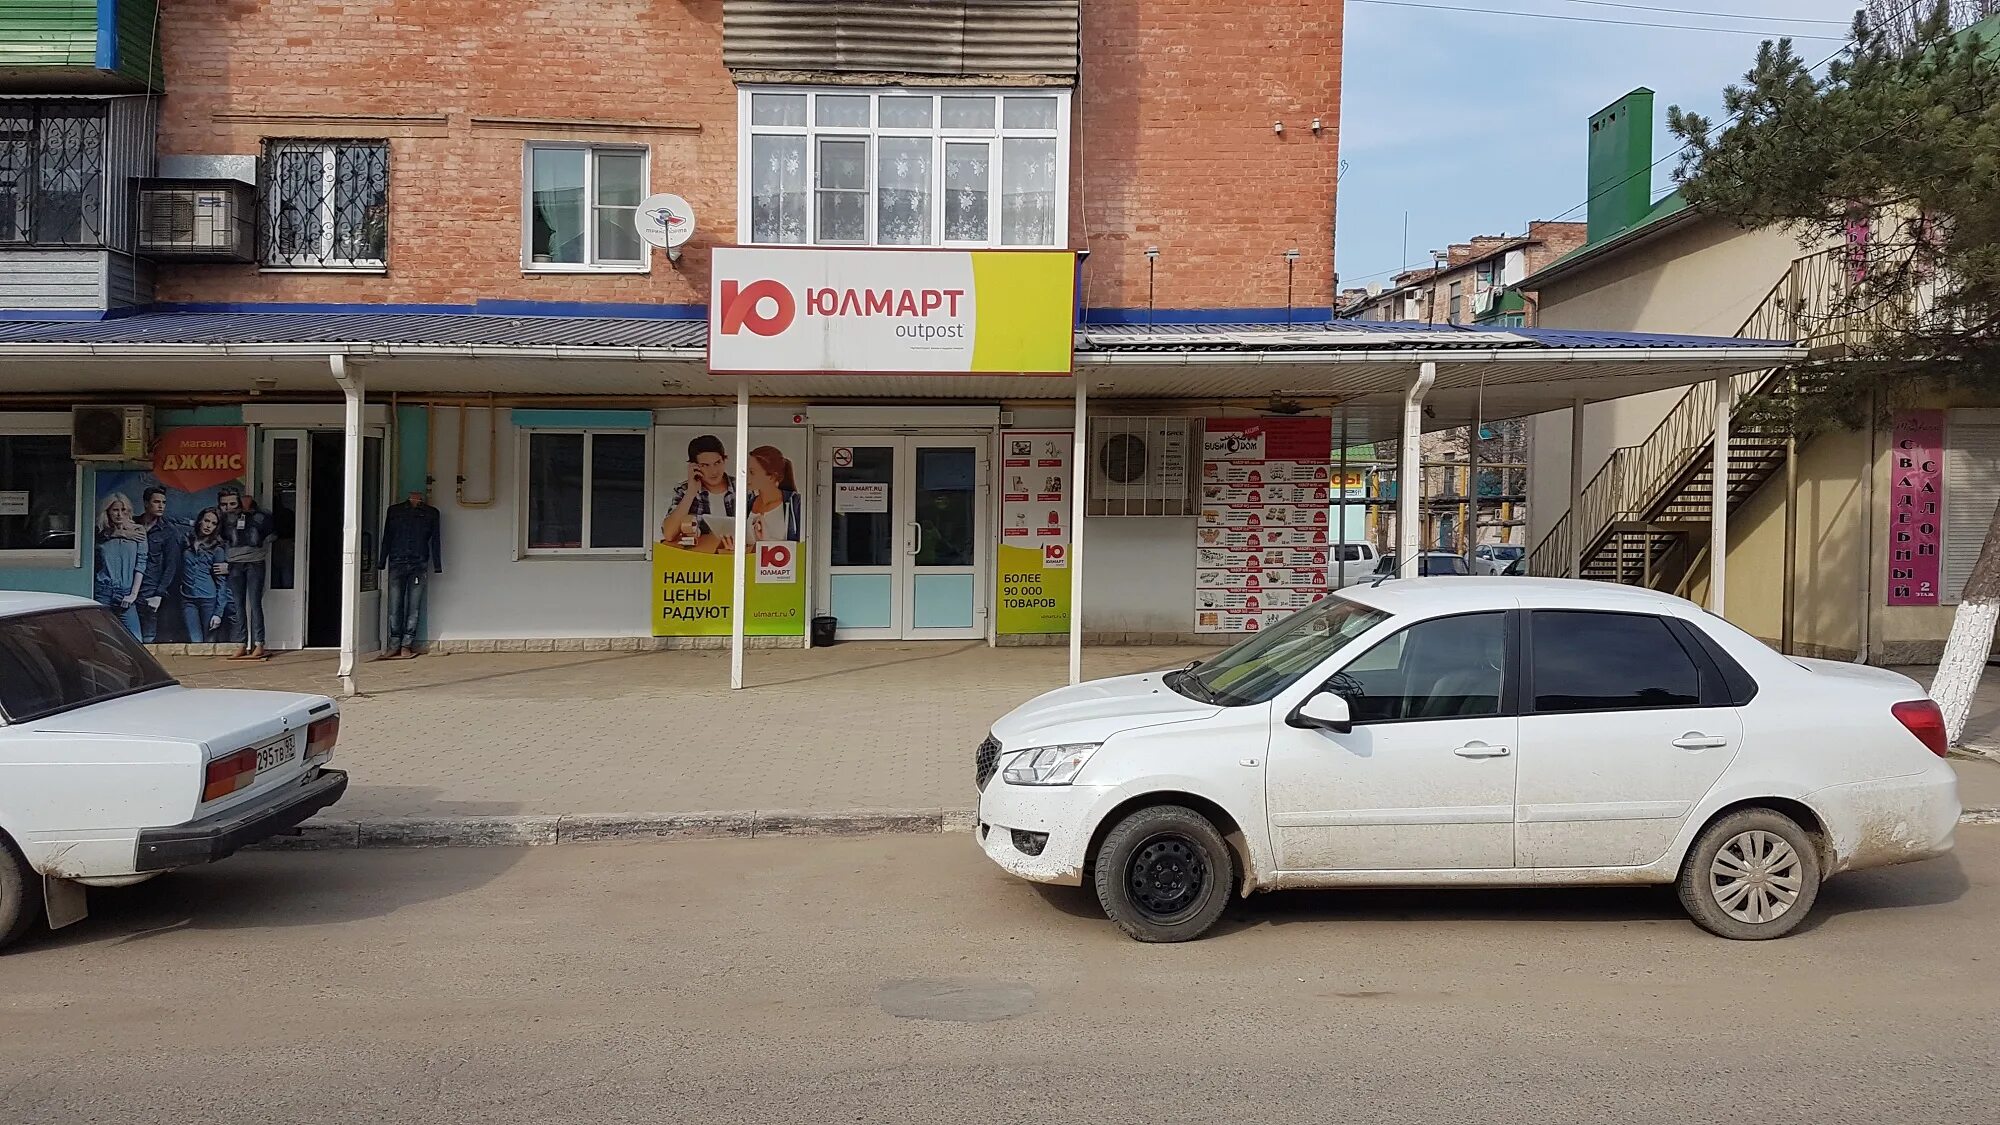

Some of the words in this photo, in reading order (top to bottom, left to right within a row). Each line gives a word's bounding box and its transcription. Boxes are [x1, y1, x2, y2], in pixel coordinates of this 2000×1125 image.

[807, 288, 965, 317] ЮЛМАРТ
[895, 323, 964, 341] outpost
[181, 440, 227, 449] магазин
[1205, 441, 1227, 450] SUSHI
[1240, 441, 1257, 450] DOM
[163, 453, 242, 471] ДЖИНС
[1917, 460, 1936, 556] САЛОН
[1892, 439, 1915, 598] СВАДЕБНЫЙ
[663, 571, 713, 584] НАШИ
[1004, 574, 1041, 583] БОЛЕЕ
[1004, 587, 1018, 596] 90
[1022, 587, 1042, 596] 000
[1920, 581, 1931, 592] 2
[663, 589, 711, 603] ЦЕНЫ
[1004, 599, 1056, 609] ТОВАРОВ
[663, 606, 730, 621] РАДУЮТ
[753, 609, 788, 618] ulmart.ru
